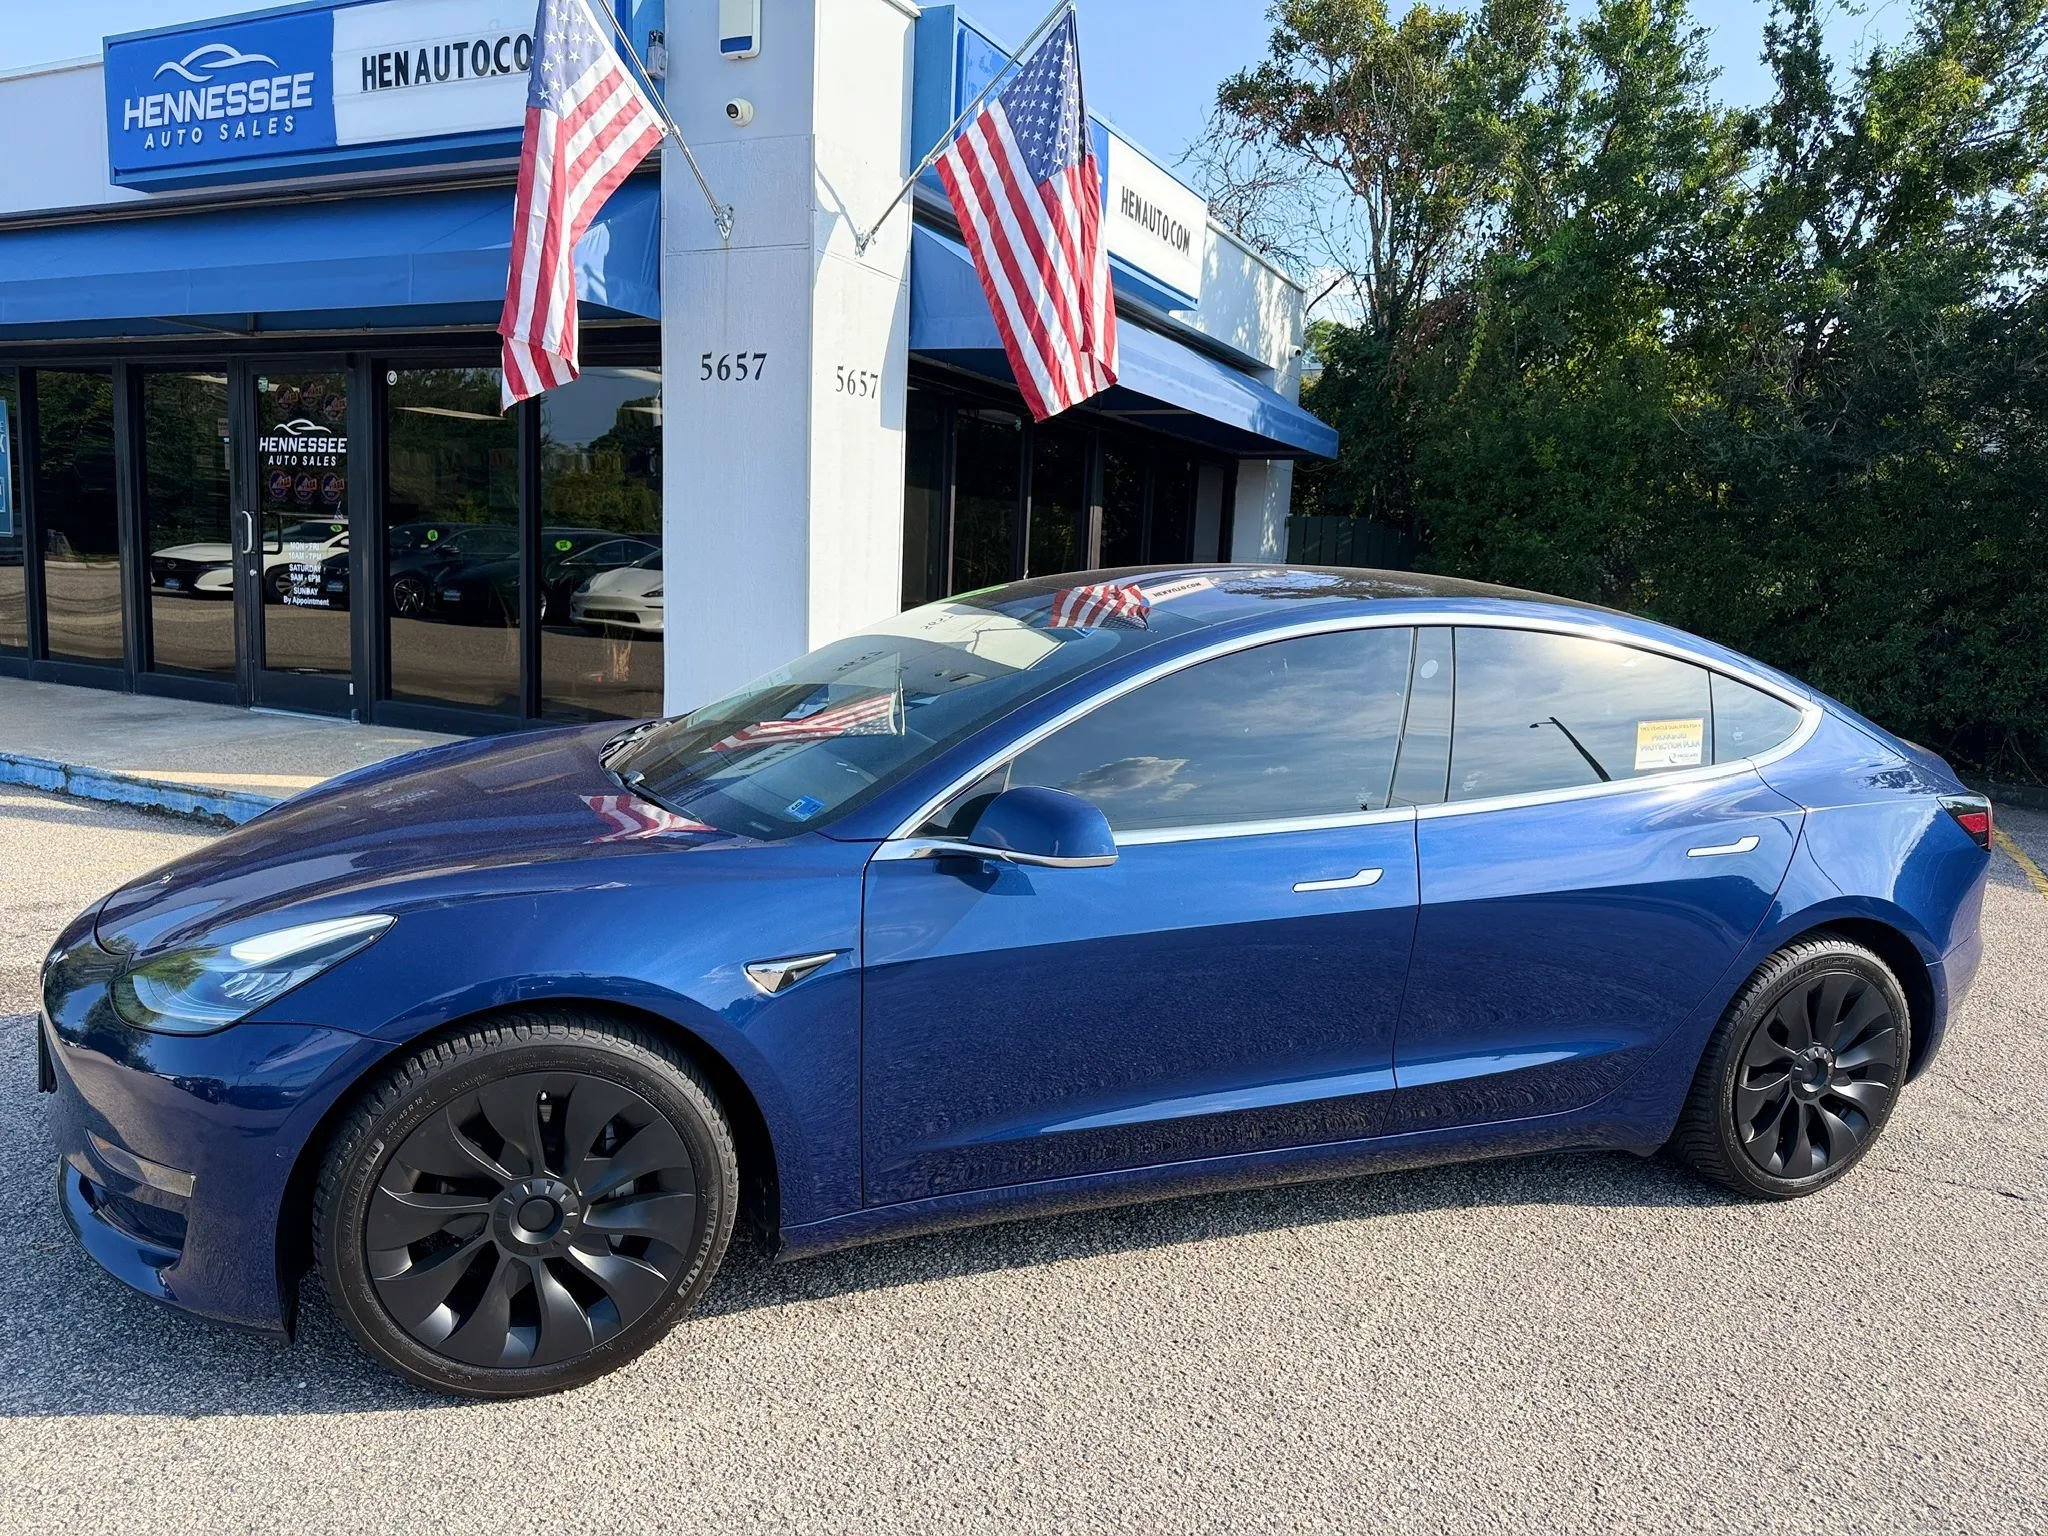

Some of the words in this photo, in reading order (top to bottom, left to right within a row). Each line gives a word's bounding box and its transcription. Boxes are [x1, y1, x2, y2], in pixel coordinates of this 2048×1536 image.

[123, 72, 314, 131] HENNESSEE
[144, 127, 203, 150] AUTO
[220, 115, 294, 141] SALES
[700, 351, 768, 382] 5657
[835, 366, 879, 399] 5657
[259, 437, 347, 453] HENNESSEE
[268, 455, 298, 466] AUTO
[302, 456, 337, 467] SALES
[289, 564, 321, 573] SATURDAY
[283, 595, 292, 605] By
[292, 596, 330, 606] Appointment
[681, 1207, 717, 1293] MICHELIN
